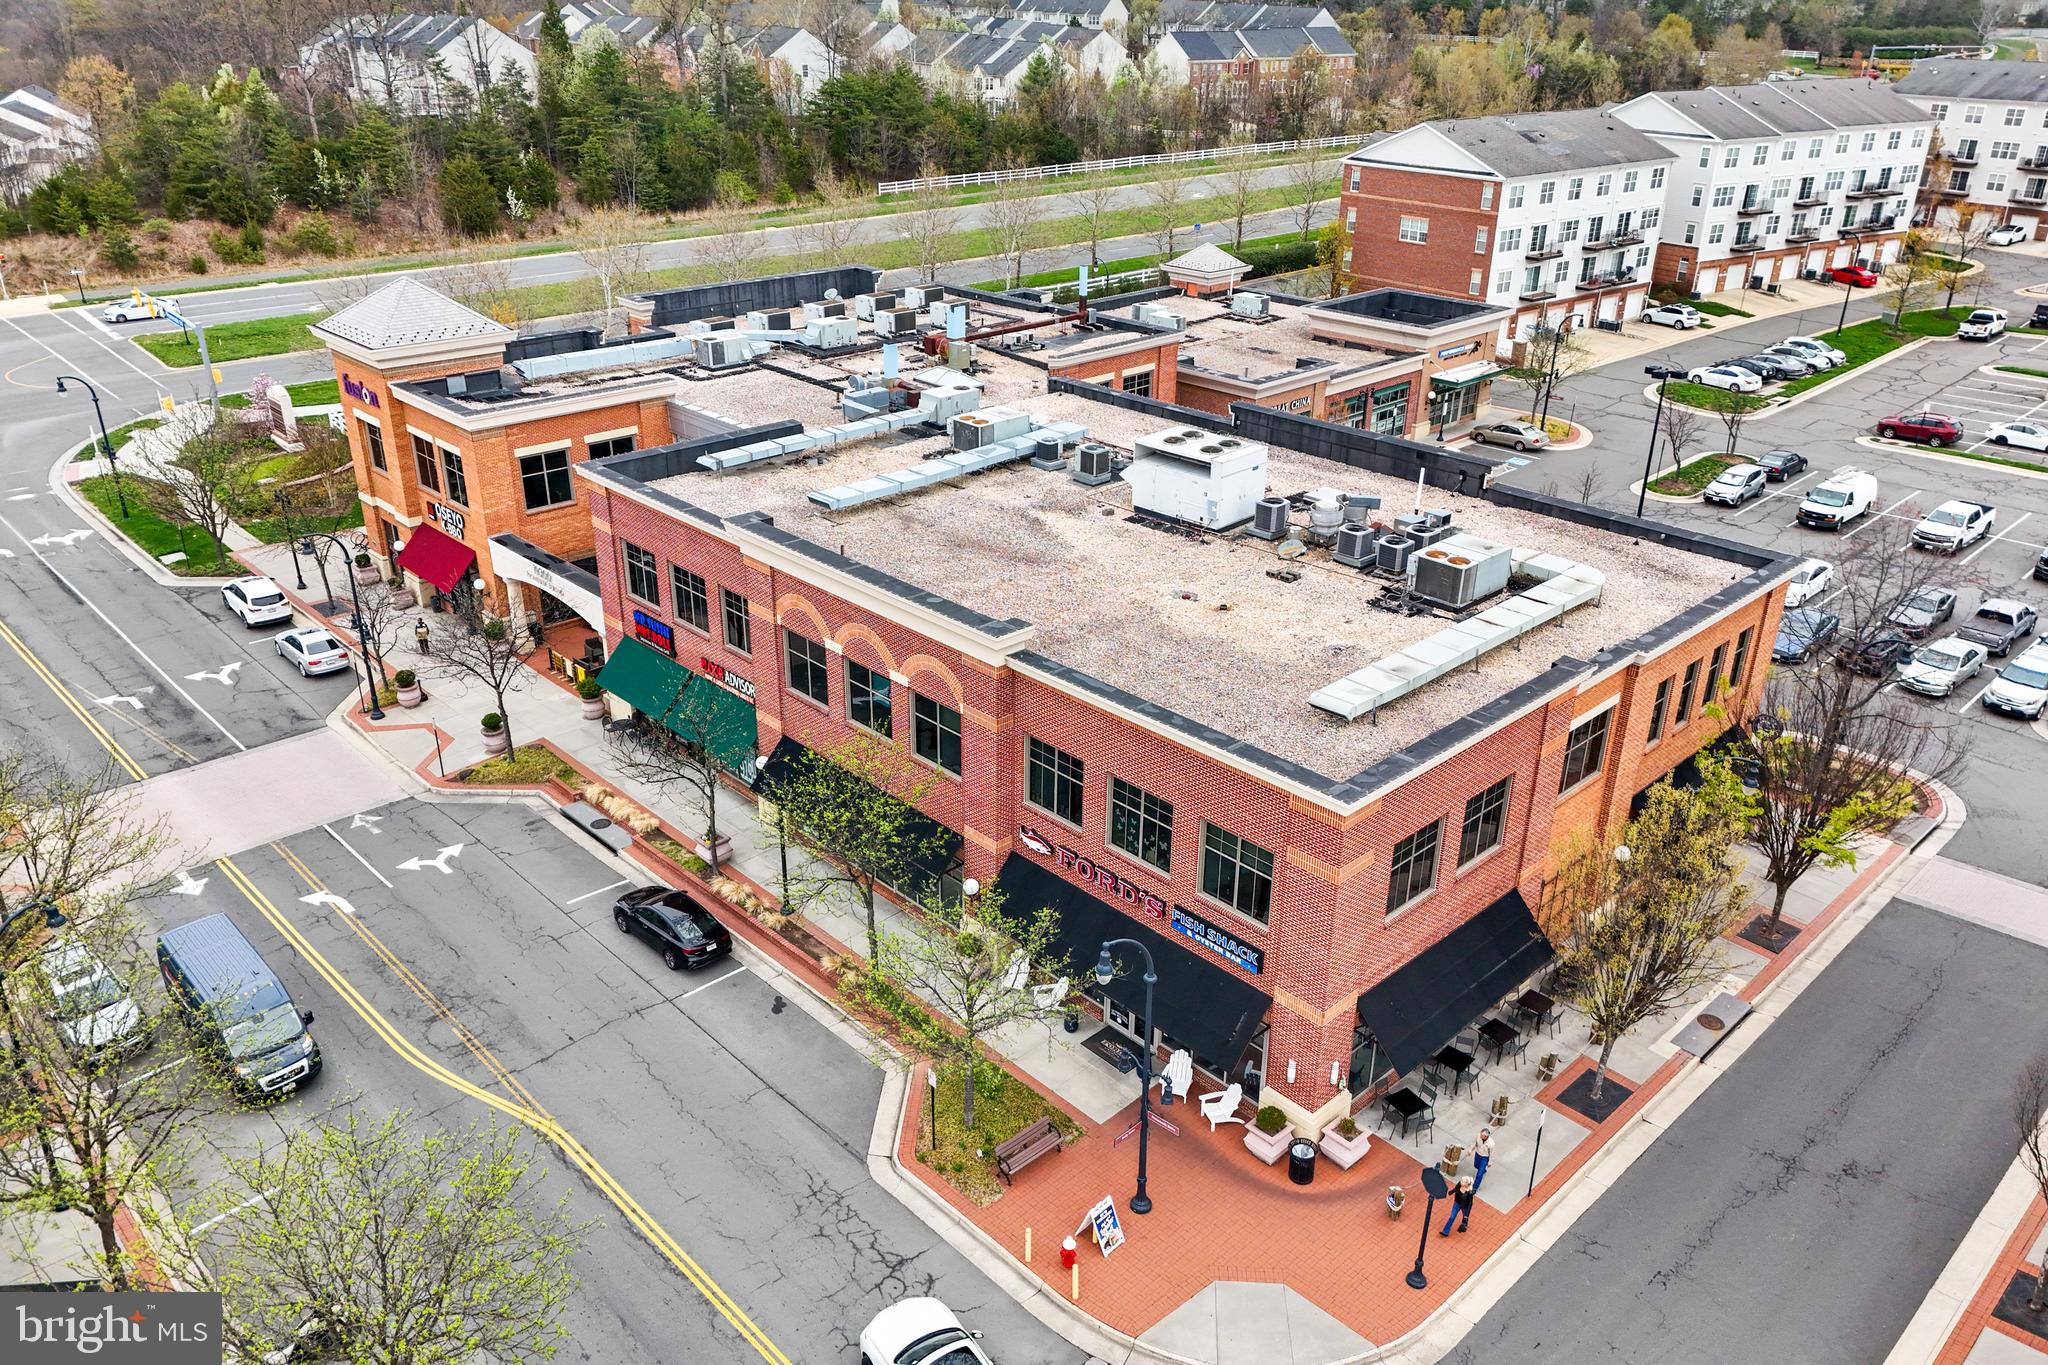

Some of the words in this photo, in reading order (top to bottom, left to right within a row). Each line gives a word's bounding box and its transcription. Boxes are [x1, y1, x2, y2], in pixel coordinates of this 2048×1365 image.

[342, 373, 379, 408] fusion
[1291, 397, 1310, 410] CHINA
[435, 503, 464, 528] OSEYO
[441, 519, 462, 540] K-BBQ
[725, 671, 756, 698] ADVISOR
[1056, 845, 1164, 920] FORD'S
[1172, 909, 1205, 935] FISH
[1207, 928, 1259, 966] SHACK
[1187, 930, 1193, 938] &
[1195, 935, 1224, 955] OYSTER
[1225, 949, 1242, 965] BAR
